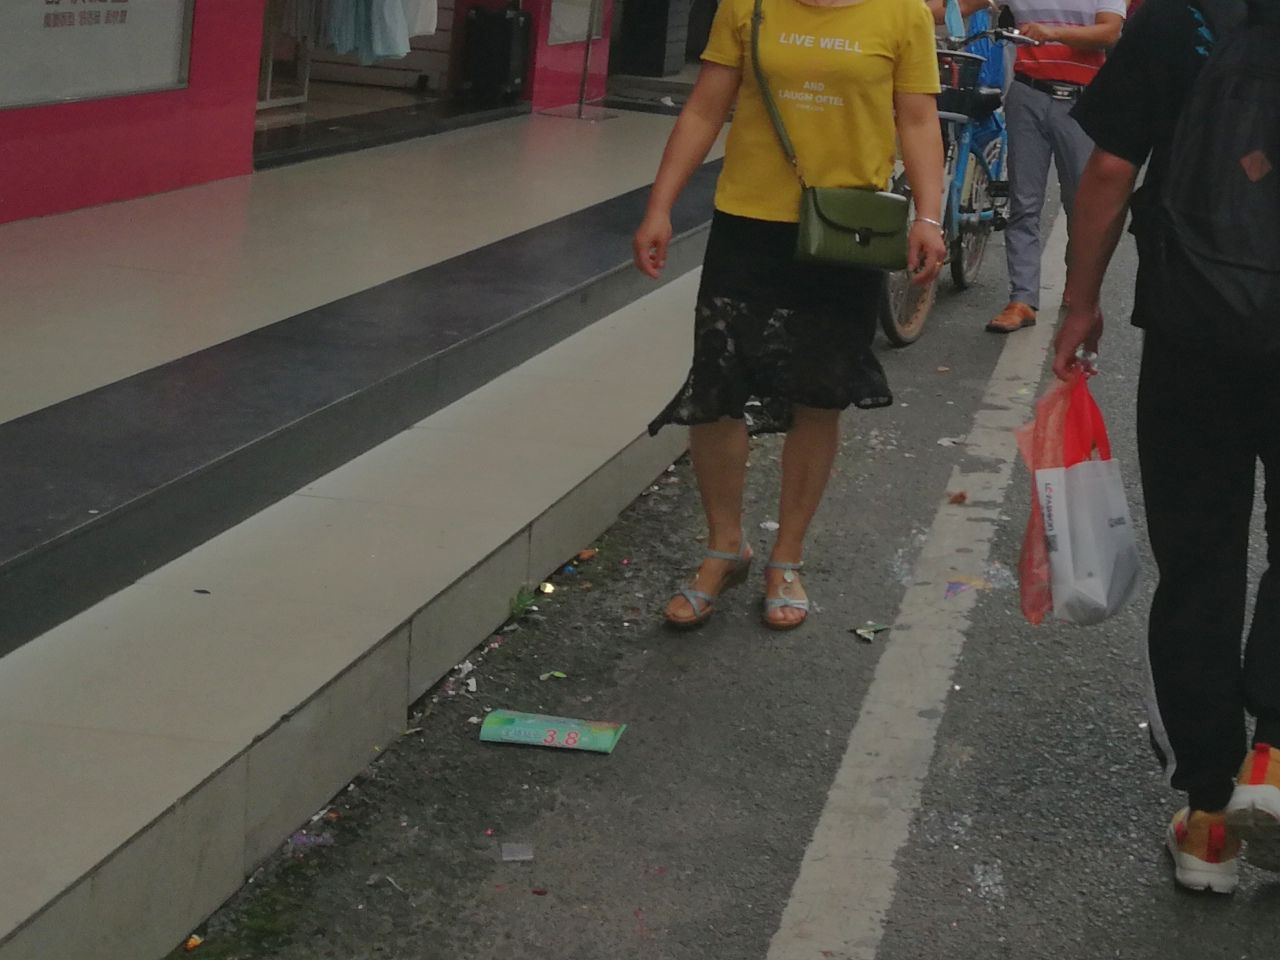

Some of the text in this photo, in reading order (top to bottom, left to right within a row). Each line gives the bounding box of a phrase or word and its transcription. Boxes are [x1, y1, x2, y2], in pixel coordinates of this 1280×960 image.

[779, 32, 862, 53] LIVE WELL
[803, 81, 825, 92] AND
